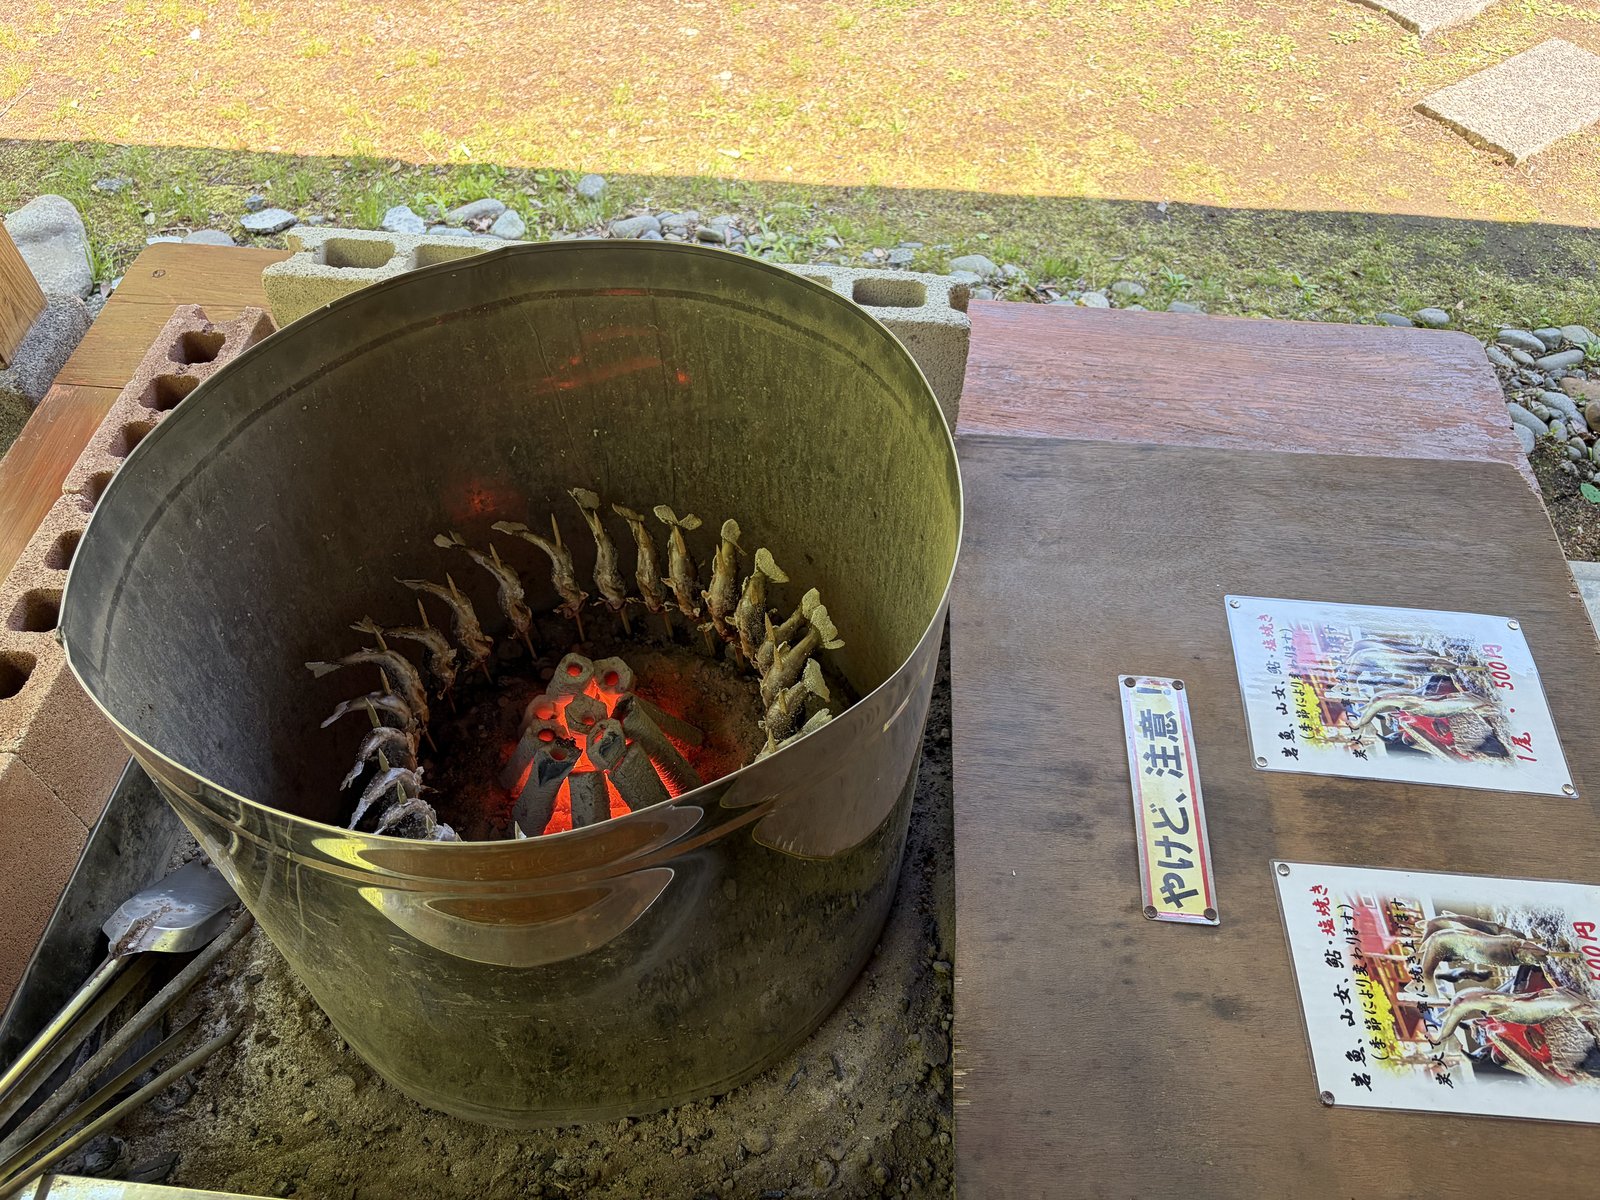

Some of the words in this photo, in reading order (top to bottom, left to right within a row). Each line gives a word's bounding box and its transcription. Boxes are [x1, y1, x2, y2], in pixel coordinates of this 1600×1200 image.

[1394, 898, 1454, 1089] 炭火で丁寧に焼き上げます
